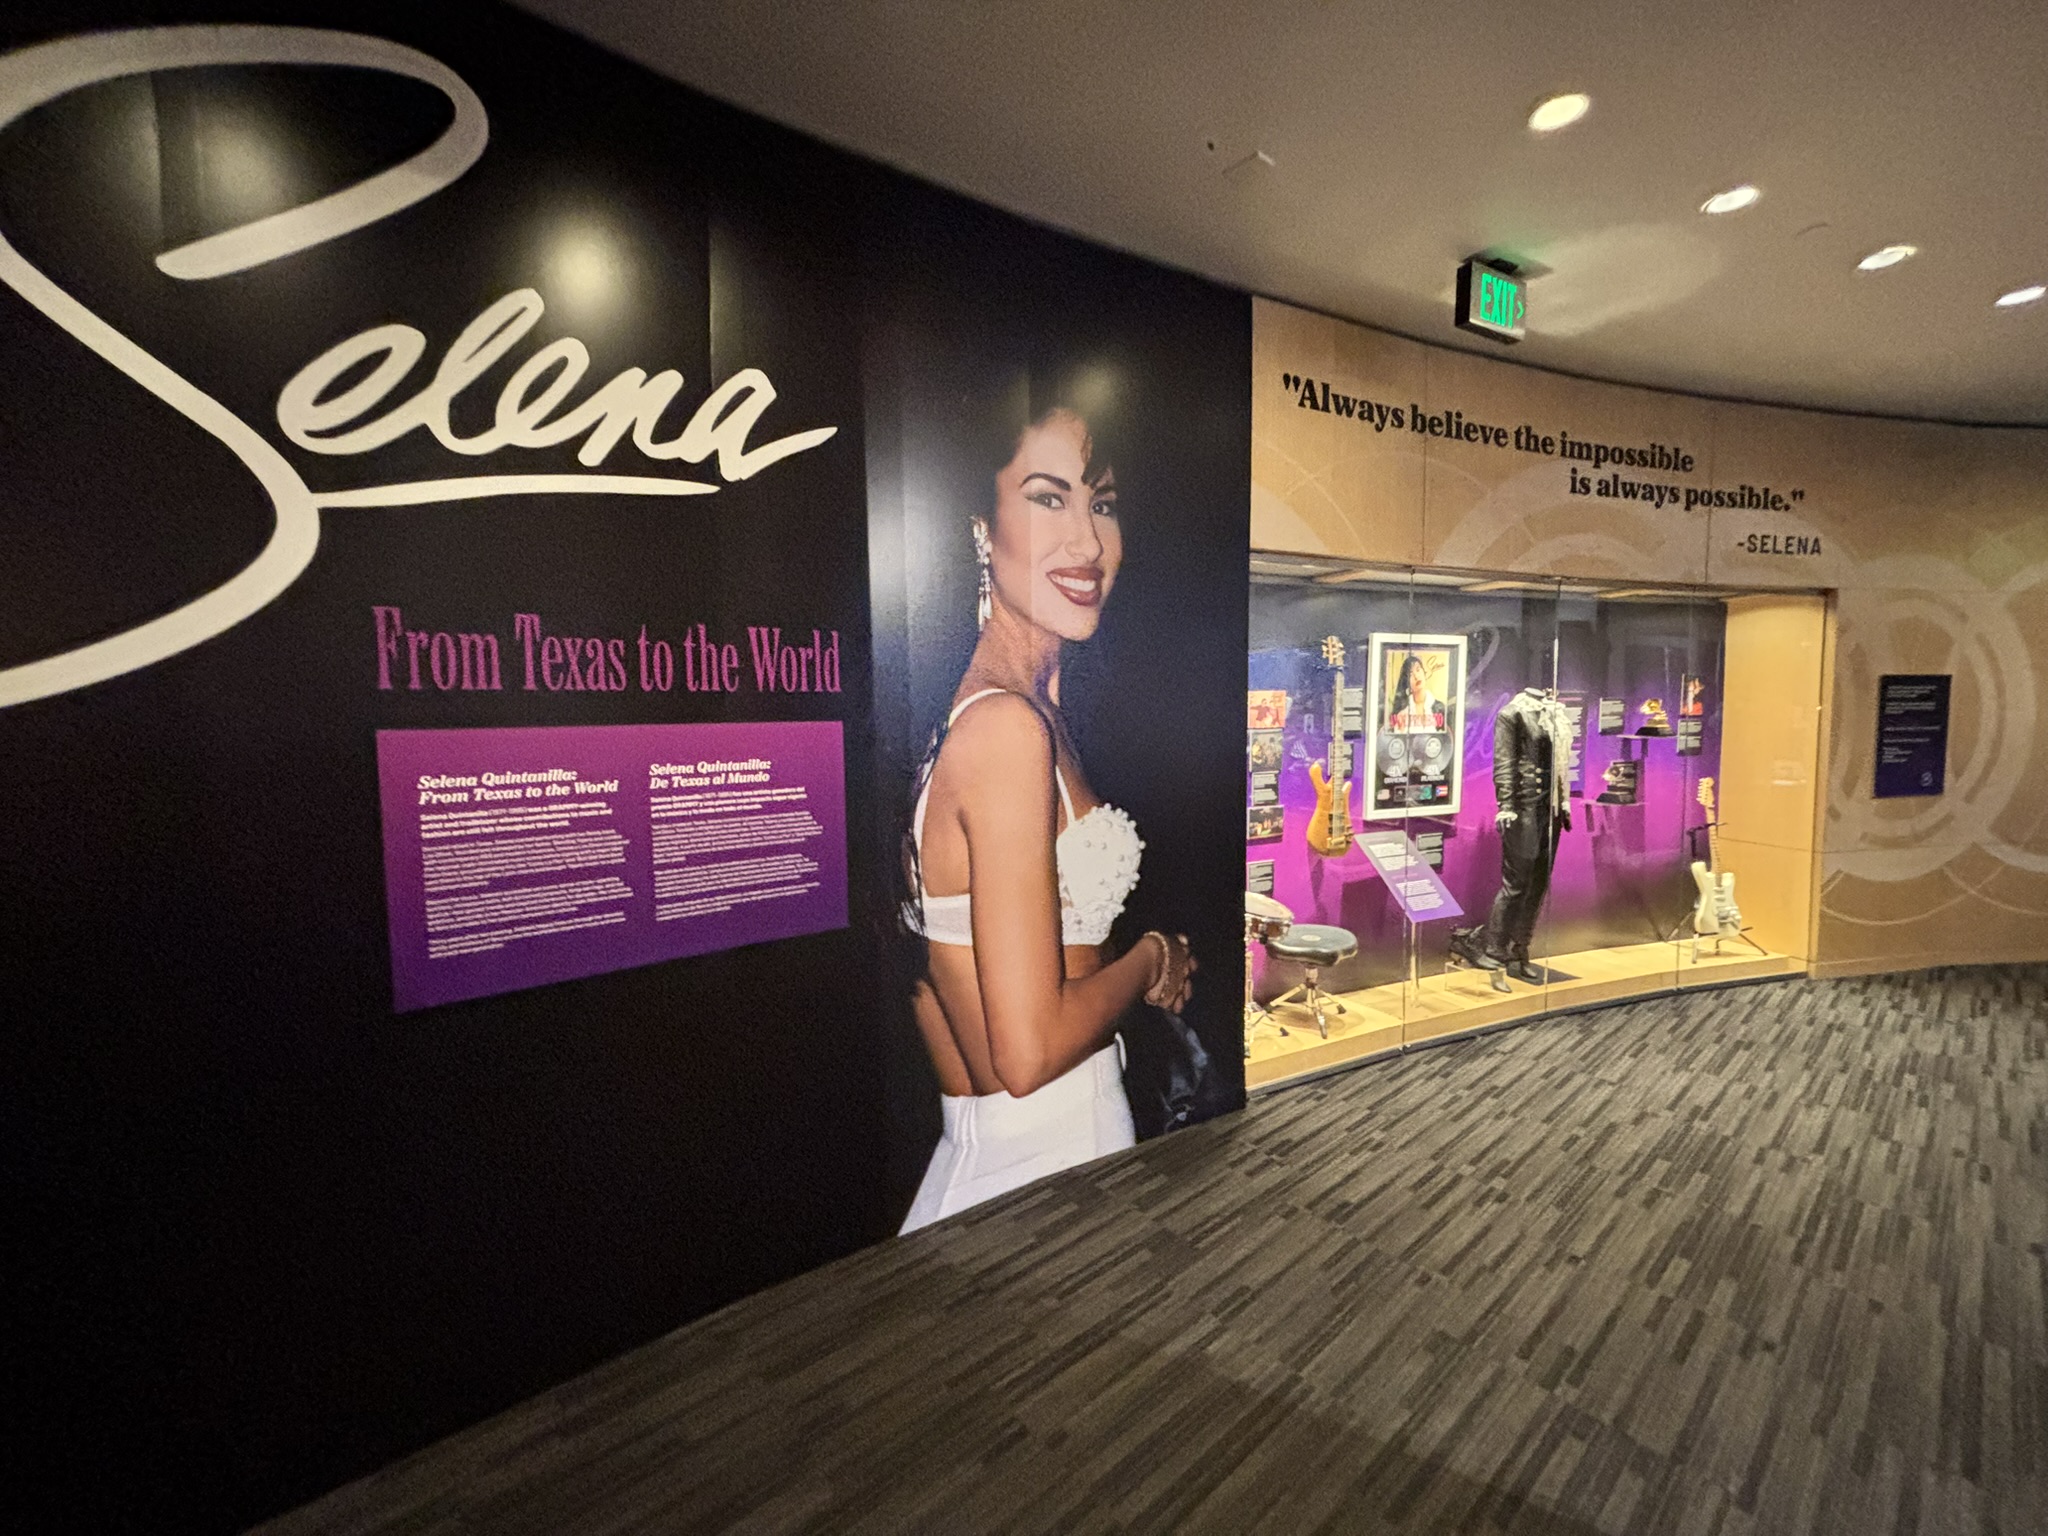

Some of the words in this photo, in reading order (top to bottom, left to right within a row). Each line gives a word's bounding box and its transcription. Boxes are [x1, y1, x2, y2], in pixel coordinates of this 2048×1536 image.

[1480, 272, 1518, 329] EXIT
[0, 24, 838, 708] Selena
[1282, 373, 1405, 431] "Always
[1410, 404, 1509, 448] believe
[1514, 426, 1555, 456] the
[1559, 432, 1695, 473] impossible
[1569, 468, 1592, 496] is
[1597, 473, 1680, 509] always
[1684, 487, 1805, 513] possible."
[1736, 534, 1822, 556] -SELENA
[372, 605, 503, 691] From
[514, 613, 628, 692] Texas
[637, 624, 674, 692] to
[684, 624, 740, 692] the
[747, 626, 842, 692] World
[417, 775, 478, 790] Selena
[481, 769, 578, 787] Quintanilla:
[649, 763, 695, 776] Selena
[697, 758, 772, 774] Quintanilla:
[650, 778, 669, 789] De
[672, 775, 711, 788] Texas
[712, 773, 726, 785] al
[727, 771, 770, 785] Mundo
[418, 791, 469, 806] From
[474, 787, 522, 802] Texas
[525, 786, 543, 799] to
[545, 783, 571, 797] the
[574, 780, 619, 795] World
